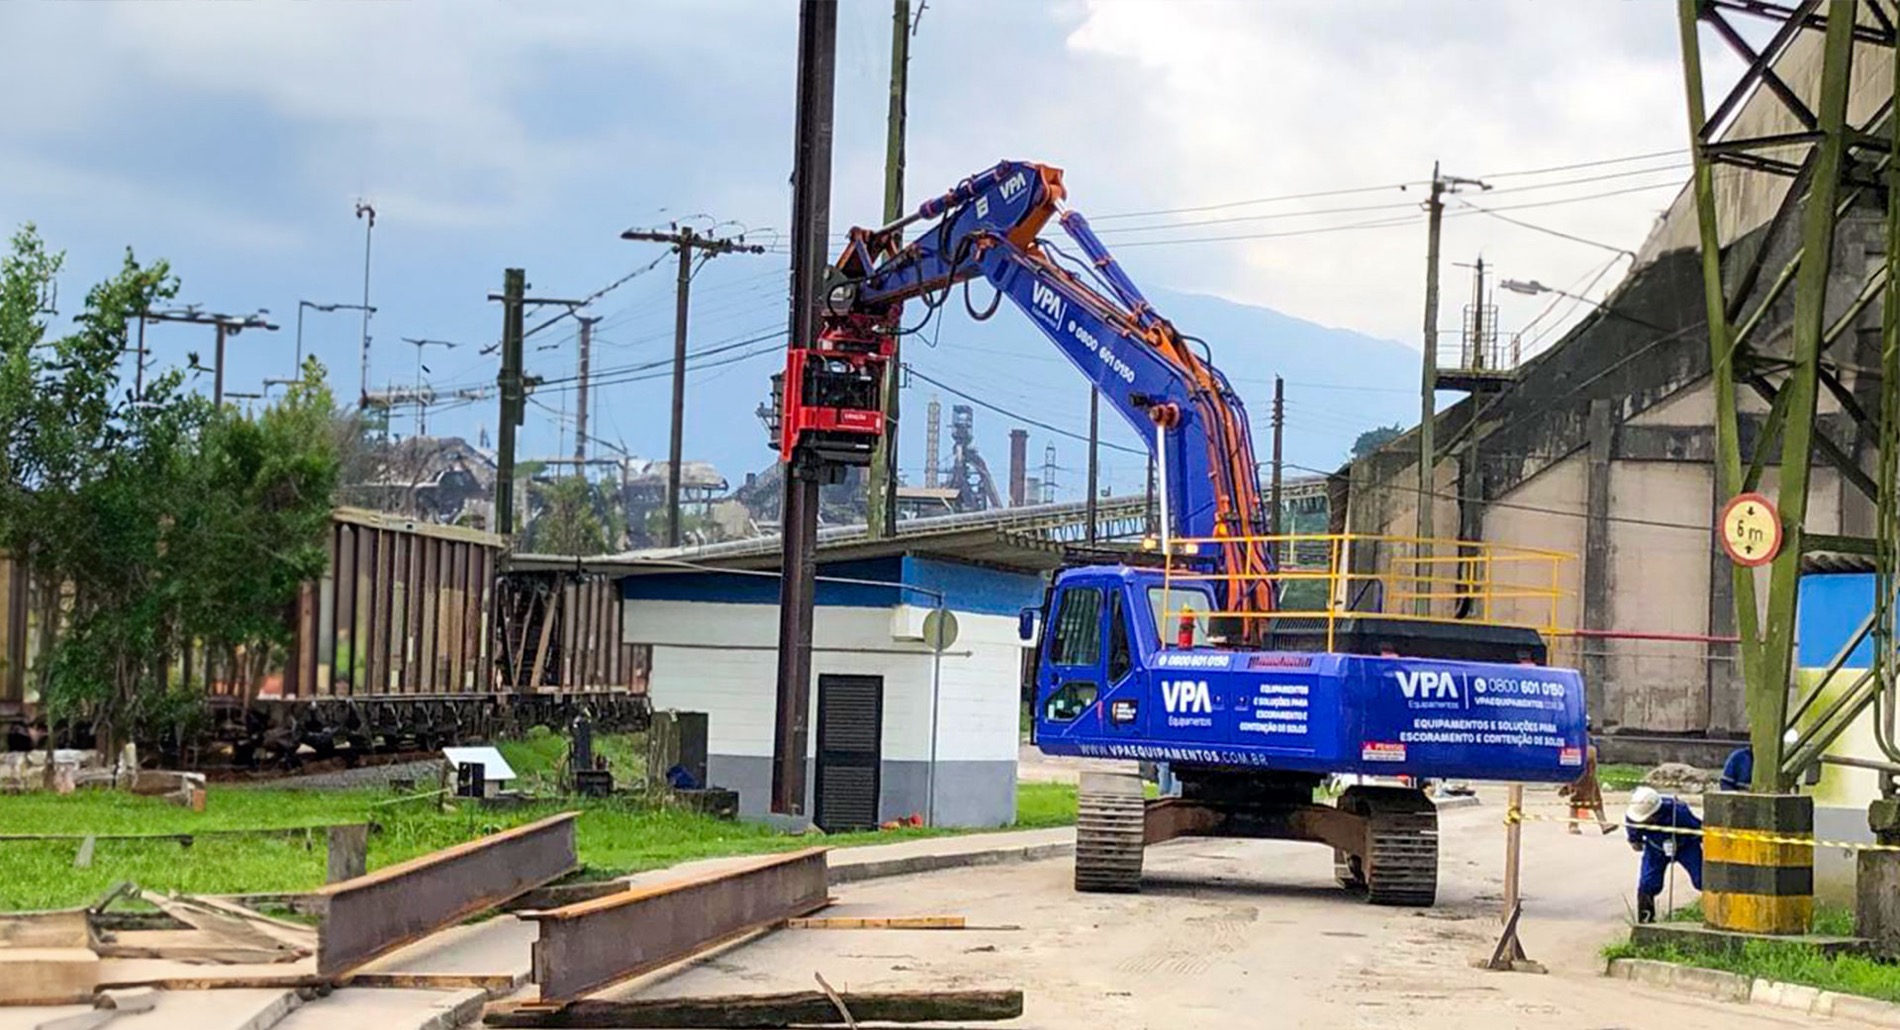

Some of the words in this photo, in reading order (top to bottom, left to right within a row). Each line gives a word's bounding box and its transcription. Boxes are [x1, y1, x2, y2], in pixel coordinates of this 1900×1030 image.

[1000, 172, 1026, 199] VPA
[1032, 280, 1061, 319] VPA
[1075, 327, 1098, 351] 0800
[1099, 346, 1115, 366] 601
[1113, 359, 1135, 383] 0150
[1737, 519, 1744, 537] 6
[1748, 527, 1763, 541] m
[1161, 681, 1212, 713] VPA
[1394, 671, 1458, 698] VPA
[1488, 678, 1518, 693] 0800
[1520, 680, 1540, 694] 601
[1541, 682, 1564, 697] 0150
[1400, 731, 1475, 743] ESCORAMENTO
[1476, 733, 1482, 743] E
[1483, 733, 1533, 748] CONTENÇÃO
[1533, 736, 1544, 745] DE
[1414, 719, 1489, 731] EQUIPAMENTOS
[1490, 720, 1496, 730] E
[1498, 720, 1538, 734] SOLUÇÕES
